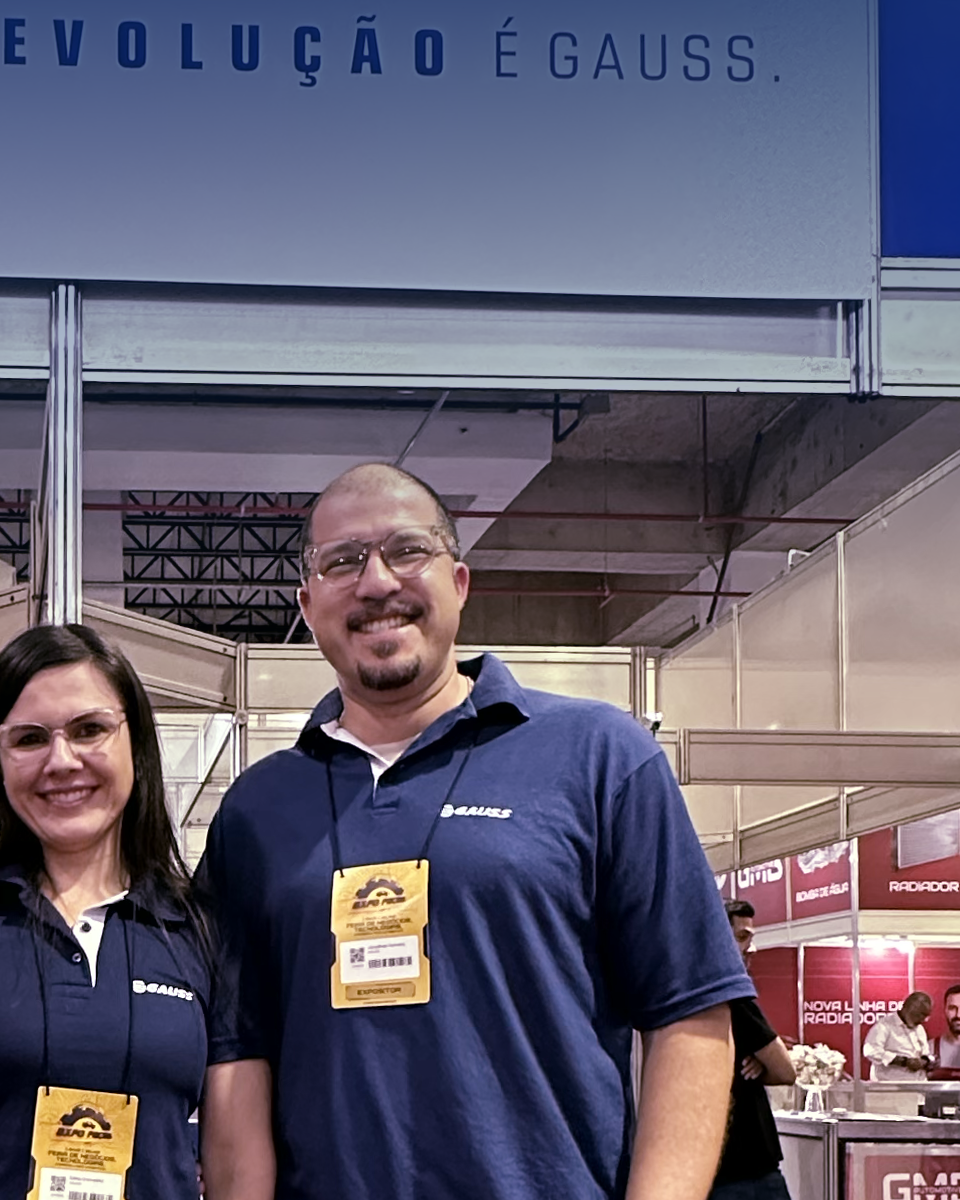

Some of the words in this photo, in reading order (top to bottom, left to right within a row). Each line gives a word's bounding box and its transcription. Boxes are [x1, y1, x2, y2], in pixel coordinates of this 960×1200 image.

[2, 15, 444, 87] EVOLUÇÃO
[495, 18, 518, 78] É
[548, 31, 781, 82] GAUSS.
[454, 806, 513, 819] GAUSS
[889, 881, 959, 892] RADIADOR
[804, 1001, 841, 1011] NOVA
[844, 1001, 886, 1011] LNHA
